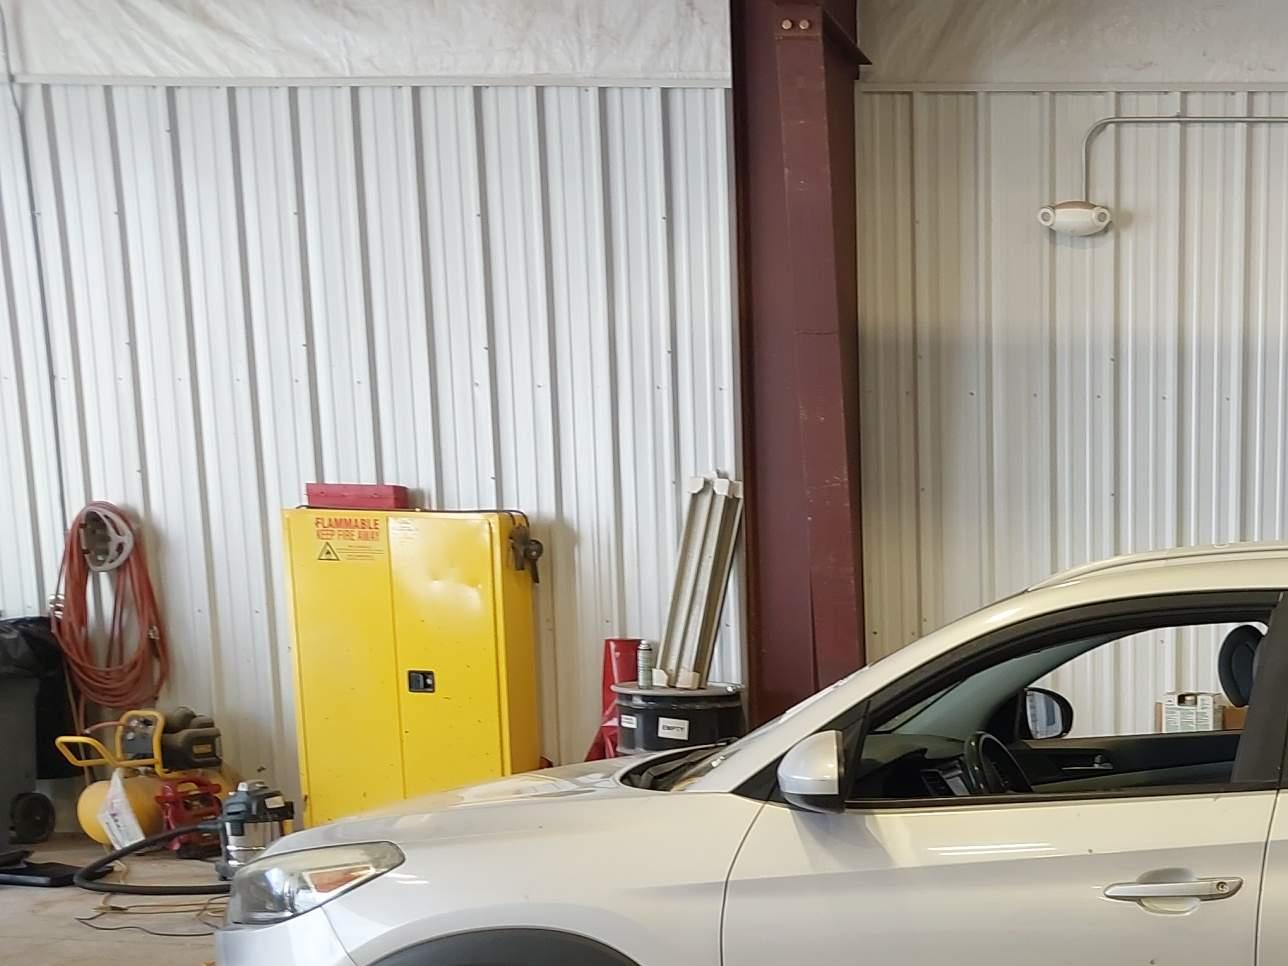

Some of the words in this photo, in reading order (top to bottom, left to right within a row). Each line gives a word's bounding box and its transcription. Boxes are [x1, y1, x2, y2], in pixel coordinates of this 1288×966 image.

[315, 517, 379, 529] FLAMMABLE
[337, 530, 355, 541] FIRE
[357, 530, 379, 541] AWAY
